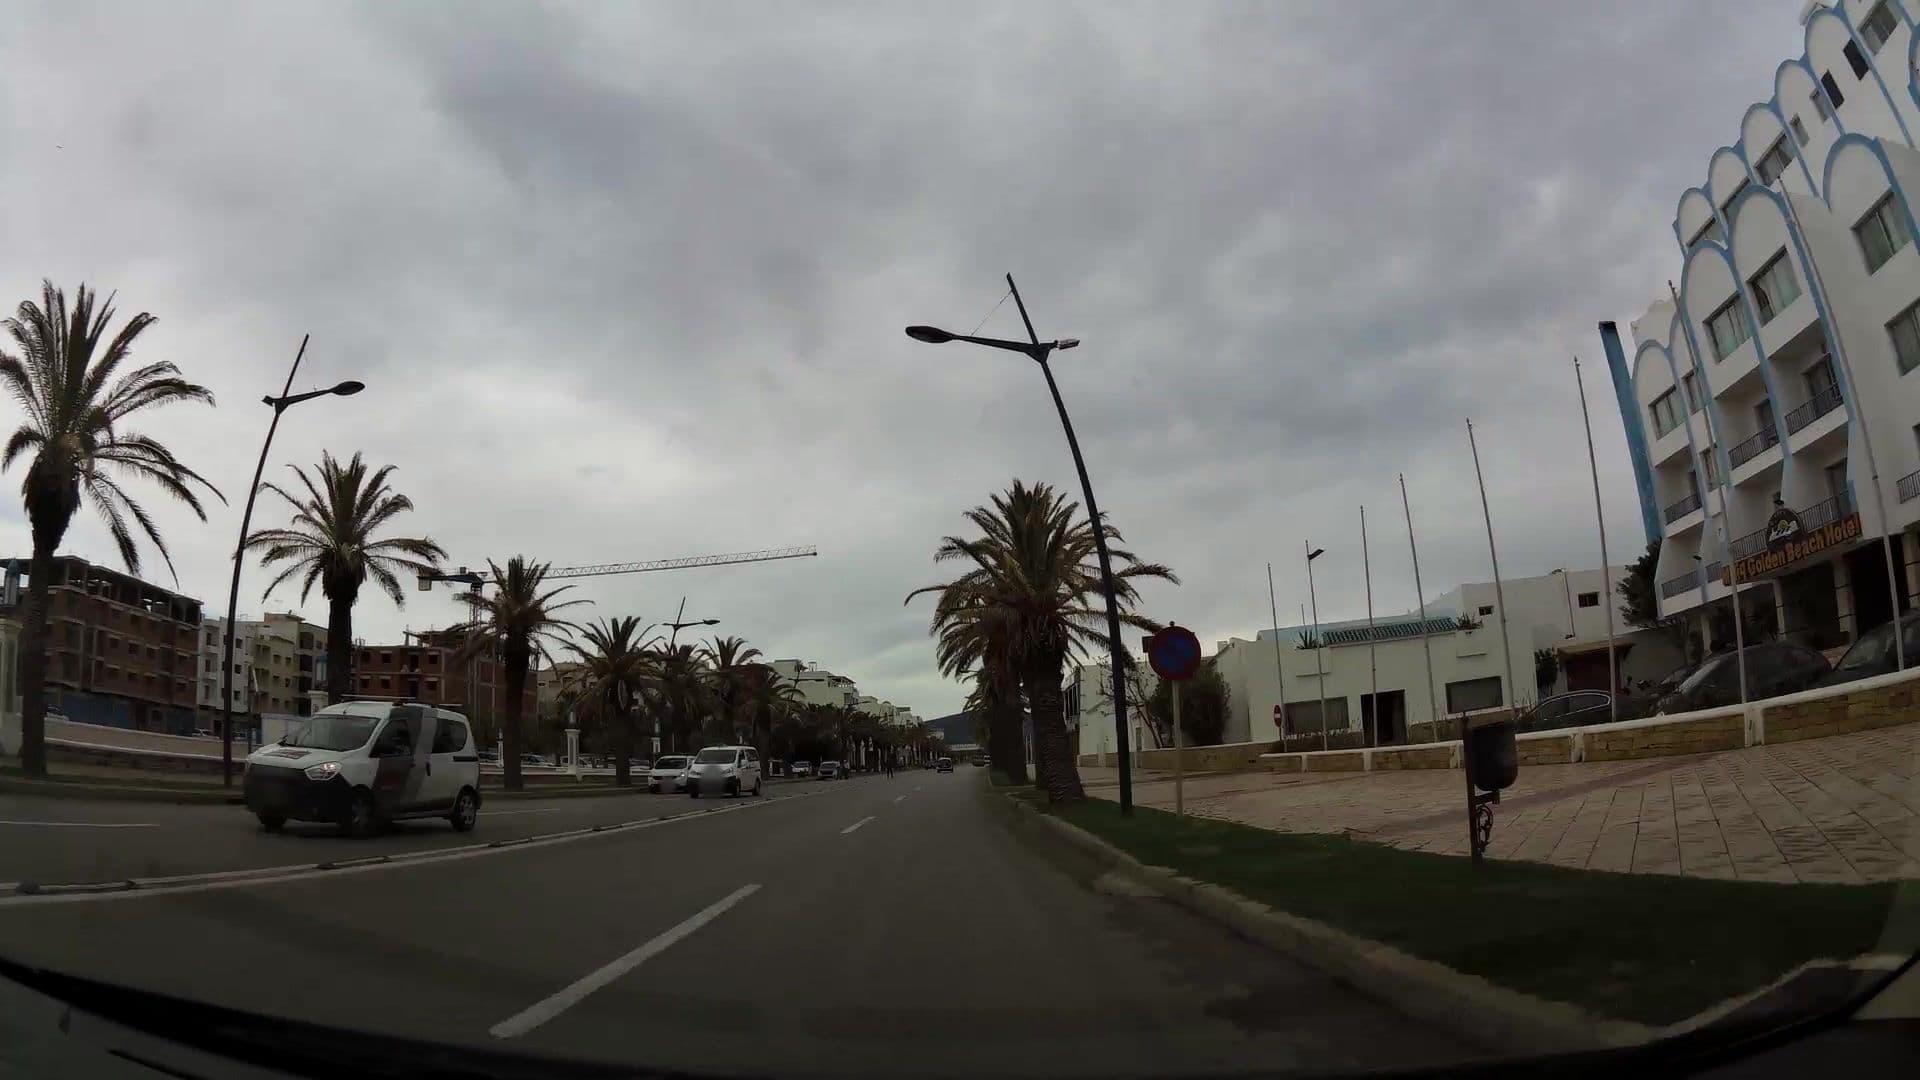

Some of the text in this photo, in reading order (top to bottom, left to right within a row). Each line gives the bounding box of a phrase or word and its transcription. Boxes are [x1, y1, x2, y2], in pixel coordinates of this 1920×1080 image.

[1747, 549, 1785, 576] Golden
[1786, 528, 1824, 561] Beach
[1825, 514, 1861, 545] Hotel
